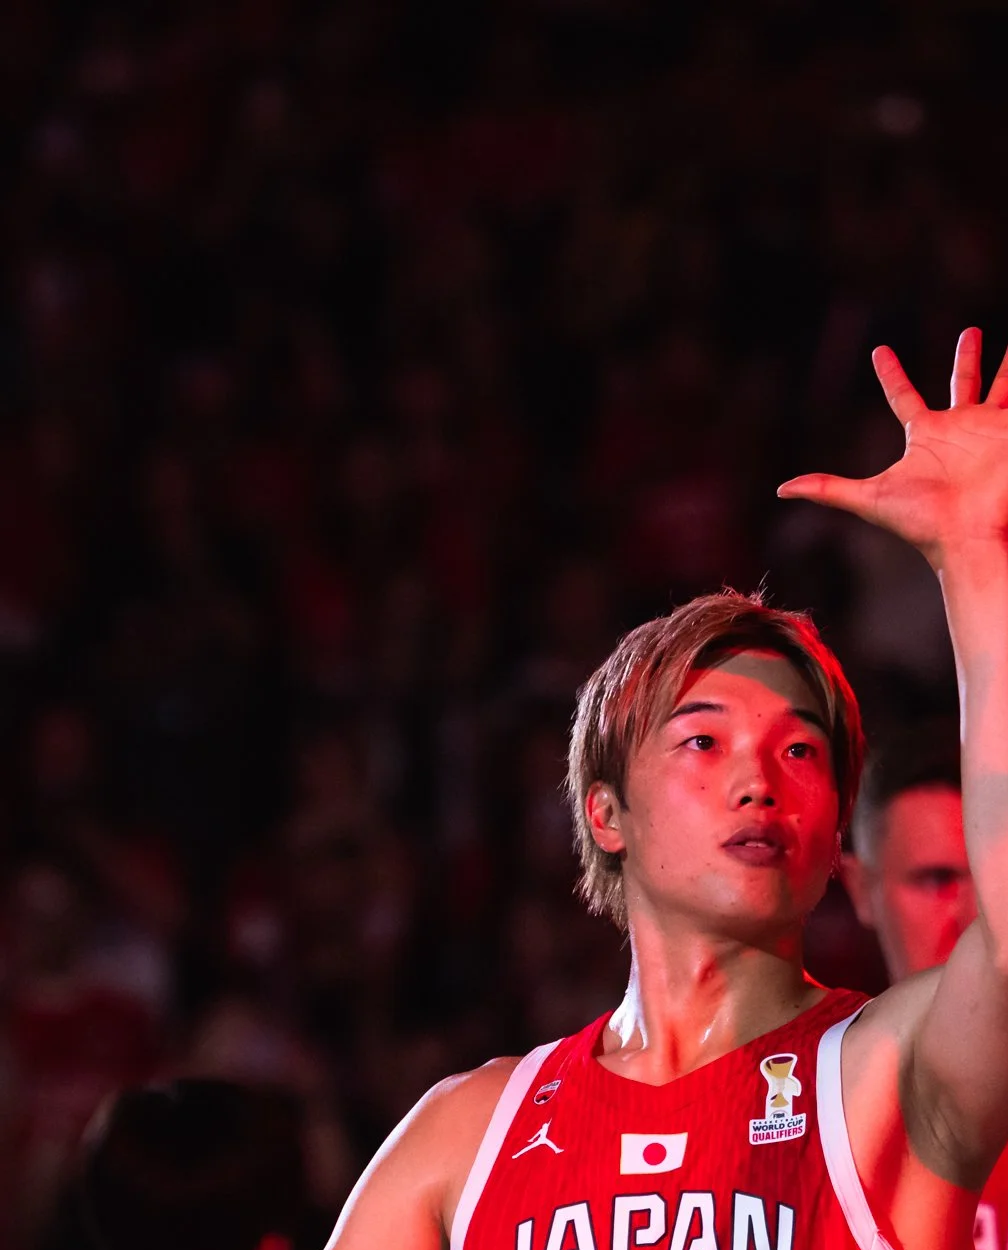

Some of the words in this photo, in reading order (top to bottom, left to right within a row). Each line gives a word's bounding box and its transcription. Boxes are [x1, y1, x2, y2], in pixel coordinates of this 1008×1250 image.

[752, 1122, 785, 1132] WORLD
[787, 1118, 804, 1128] CUP
[752, 1125, 803, 1143] QUALIFIERS
